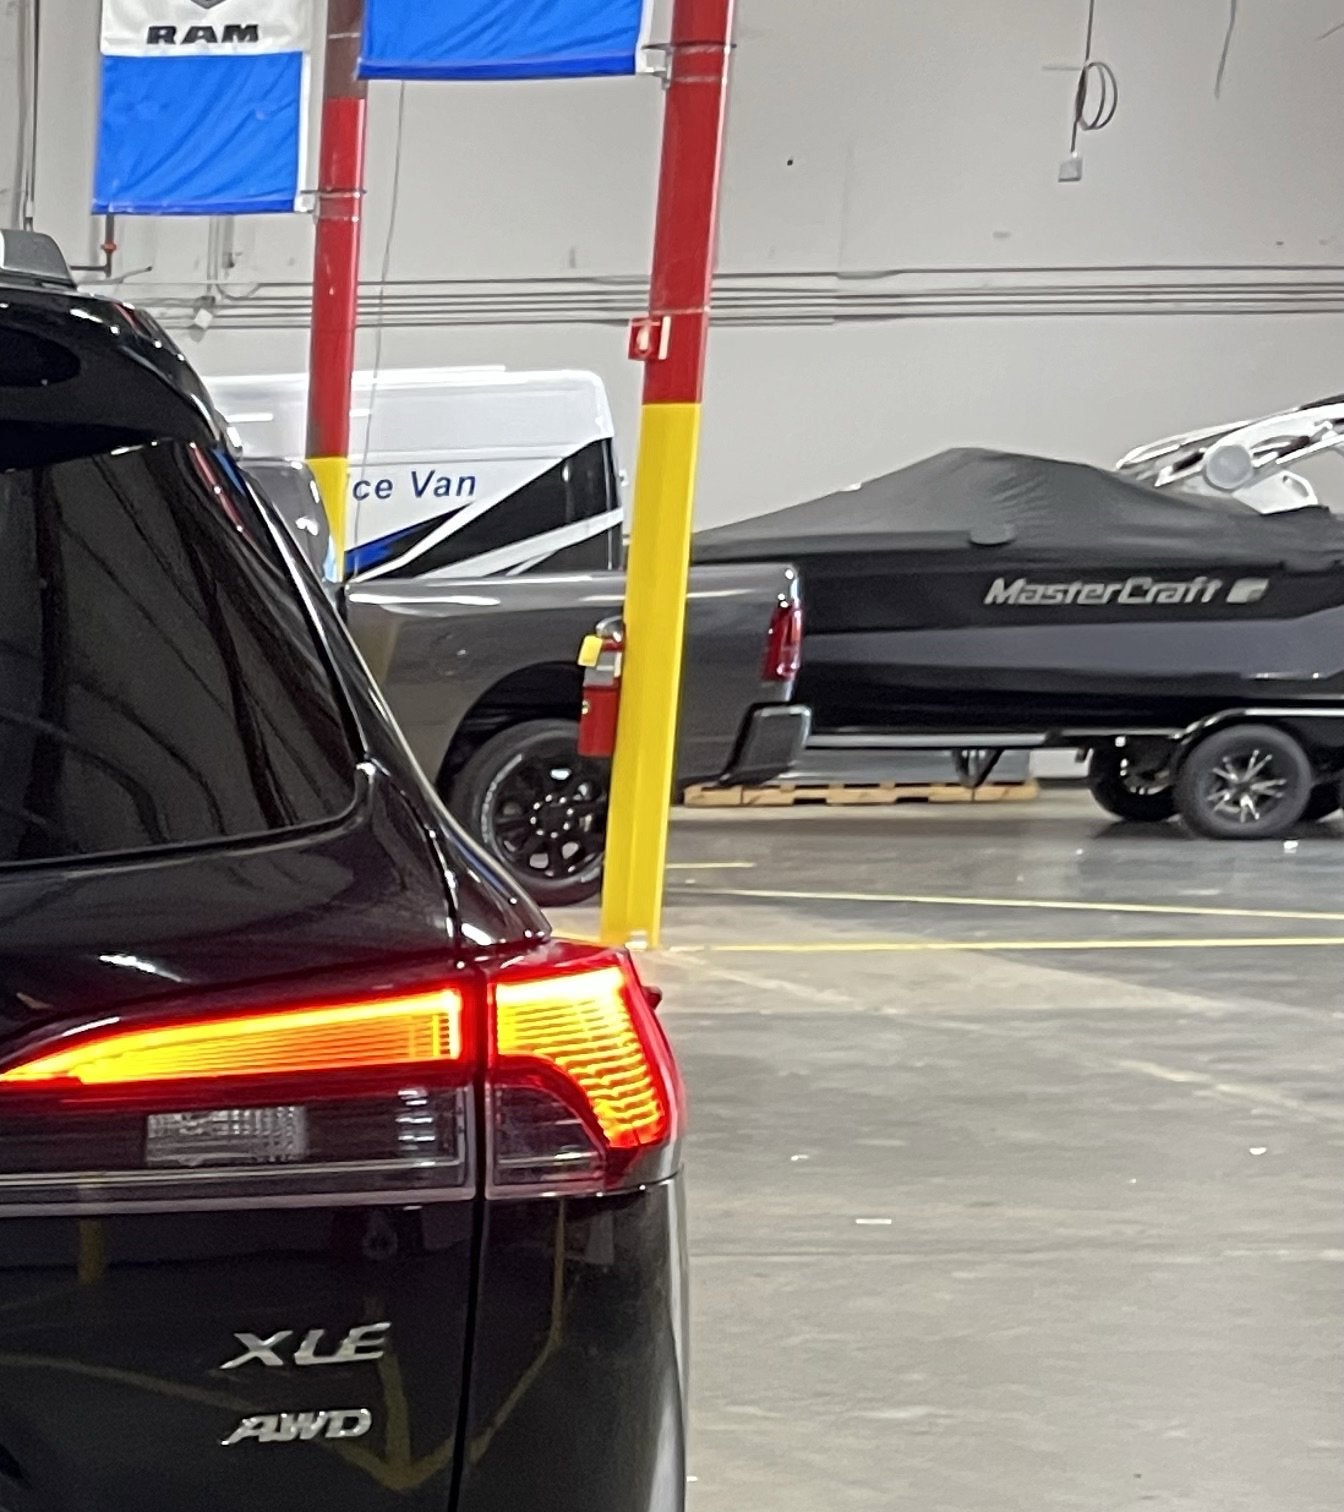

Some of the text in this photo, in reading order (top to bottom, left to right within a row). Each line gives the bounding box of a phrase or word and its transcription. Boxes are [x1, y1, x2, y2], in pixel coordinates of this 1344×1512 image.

[146, 24, 259, 45] RAM
[348, 470, 476, 500] ce Van
[984, 576, 1223, 605] MasterCraft
[219, 1321, 392, 1369] XLE
[220, 1408, 372, 1446] AWD
